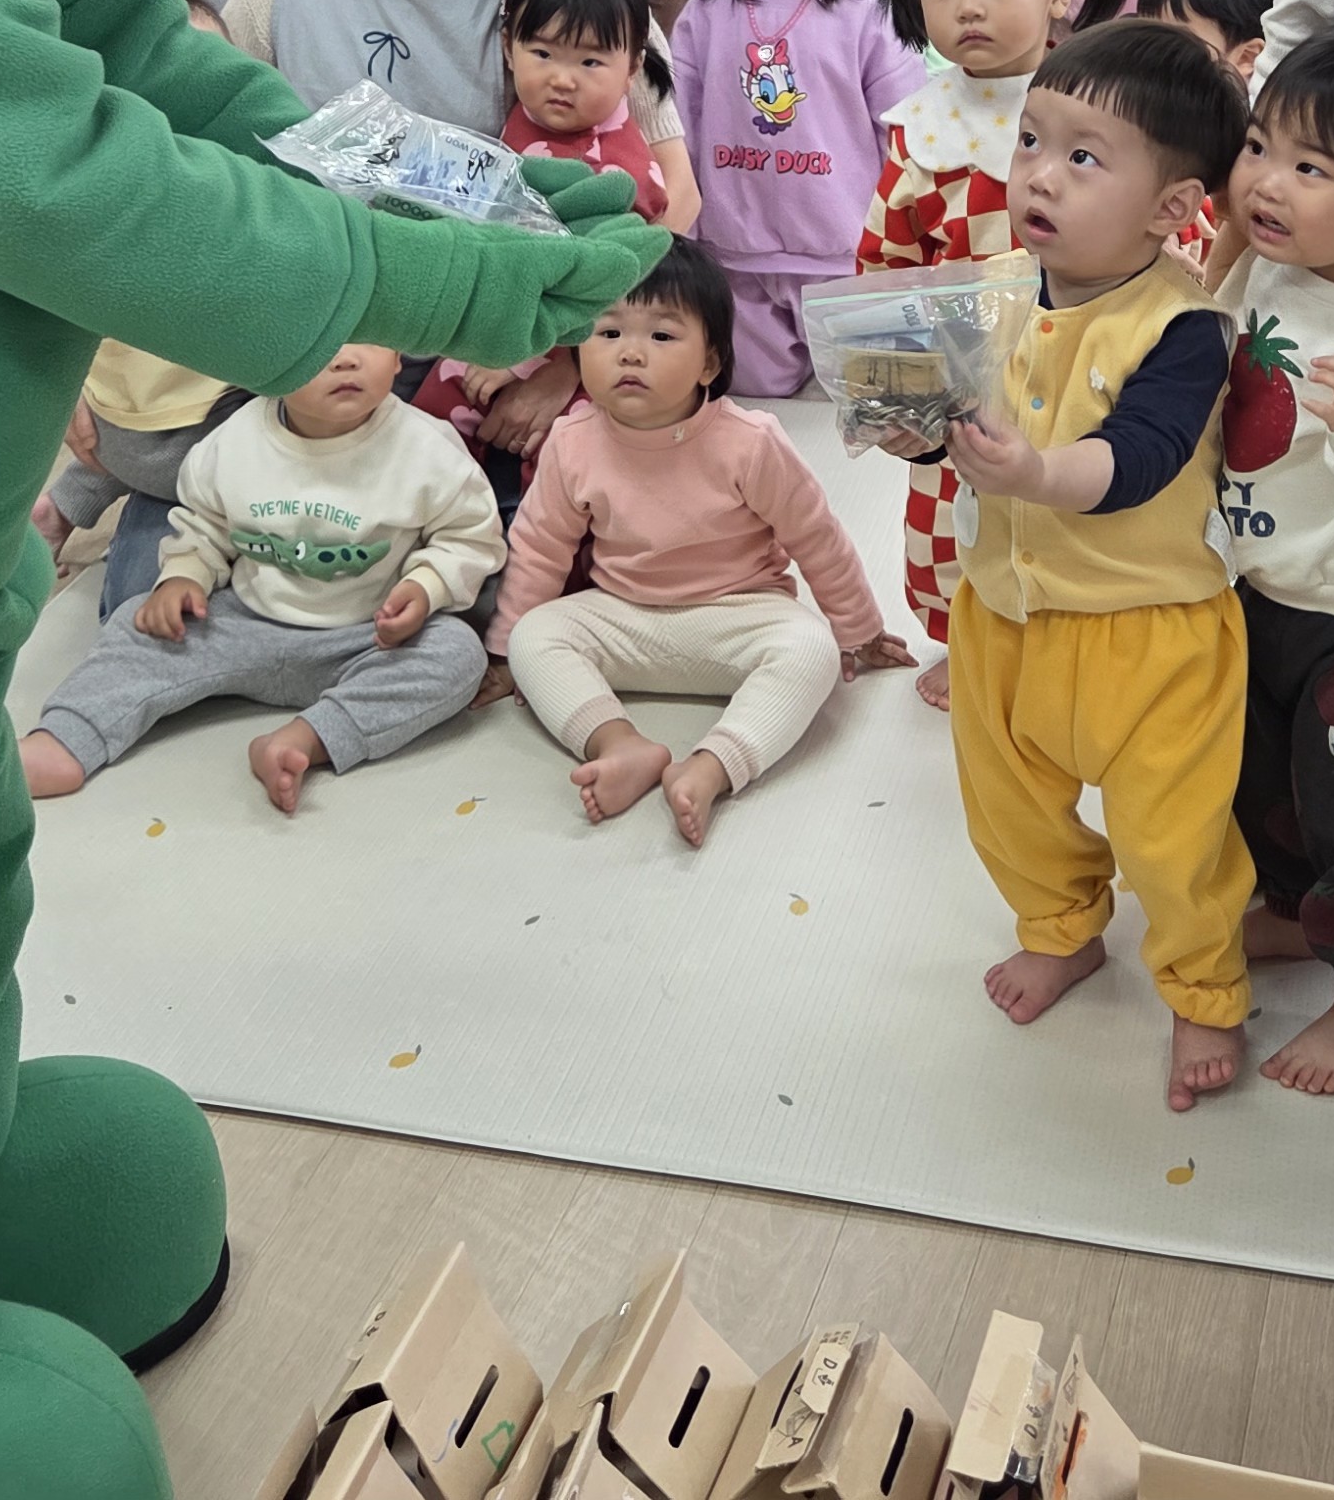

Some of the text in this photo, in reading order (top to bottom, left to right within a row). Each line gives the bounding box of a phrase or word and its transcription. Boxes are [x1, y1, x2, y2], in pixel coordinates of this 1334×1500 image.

[445, 136, 469, 152] won
[714, 144, 832, 175] DAISY DUCK
[384, 193, 435, 219] 10000
